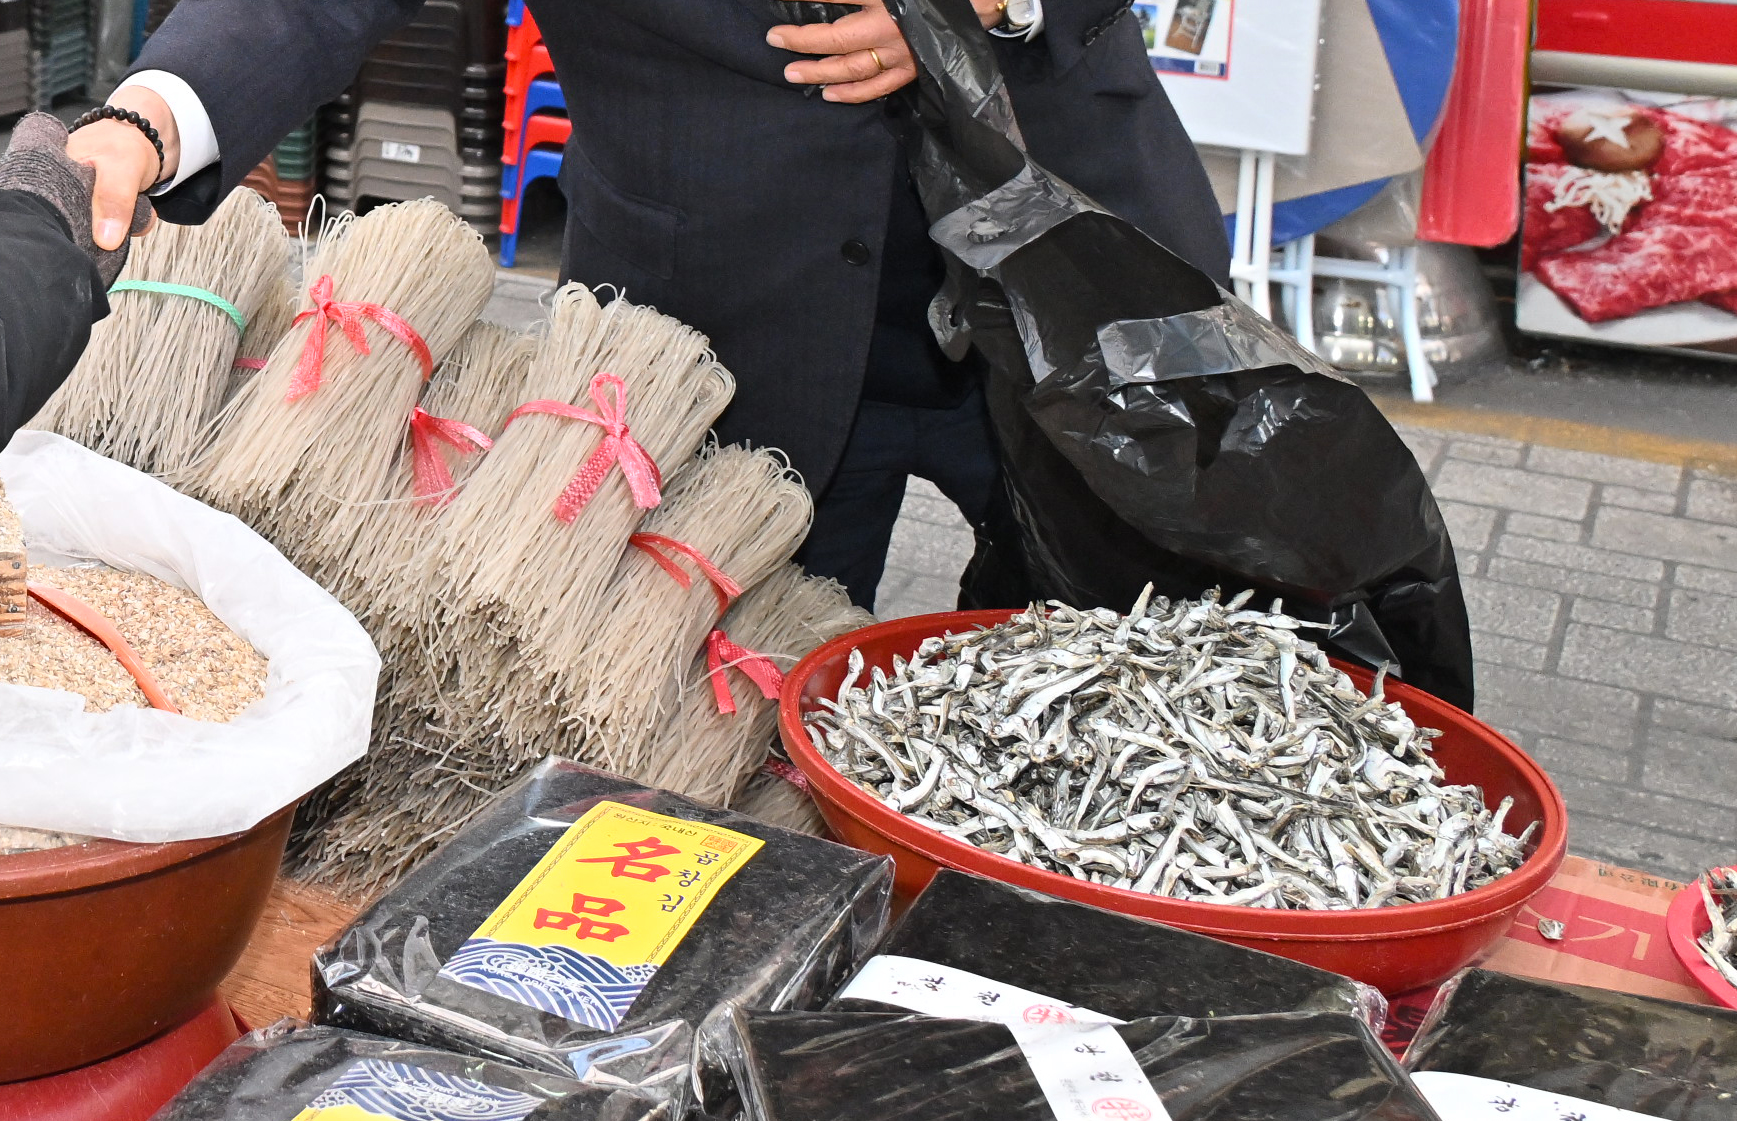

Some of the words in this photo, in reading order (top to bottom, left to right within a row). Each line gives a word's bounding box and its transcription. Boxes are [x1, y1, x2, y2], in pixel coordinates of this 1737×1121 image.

[613, 812, 652, 828] 원산지
[661, 823, 699, 838] 국내산
[533, 836, 682, 943] 名品
[657, 850, 720, 913] 곱창김
